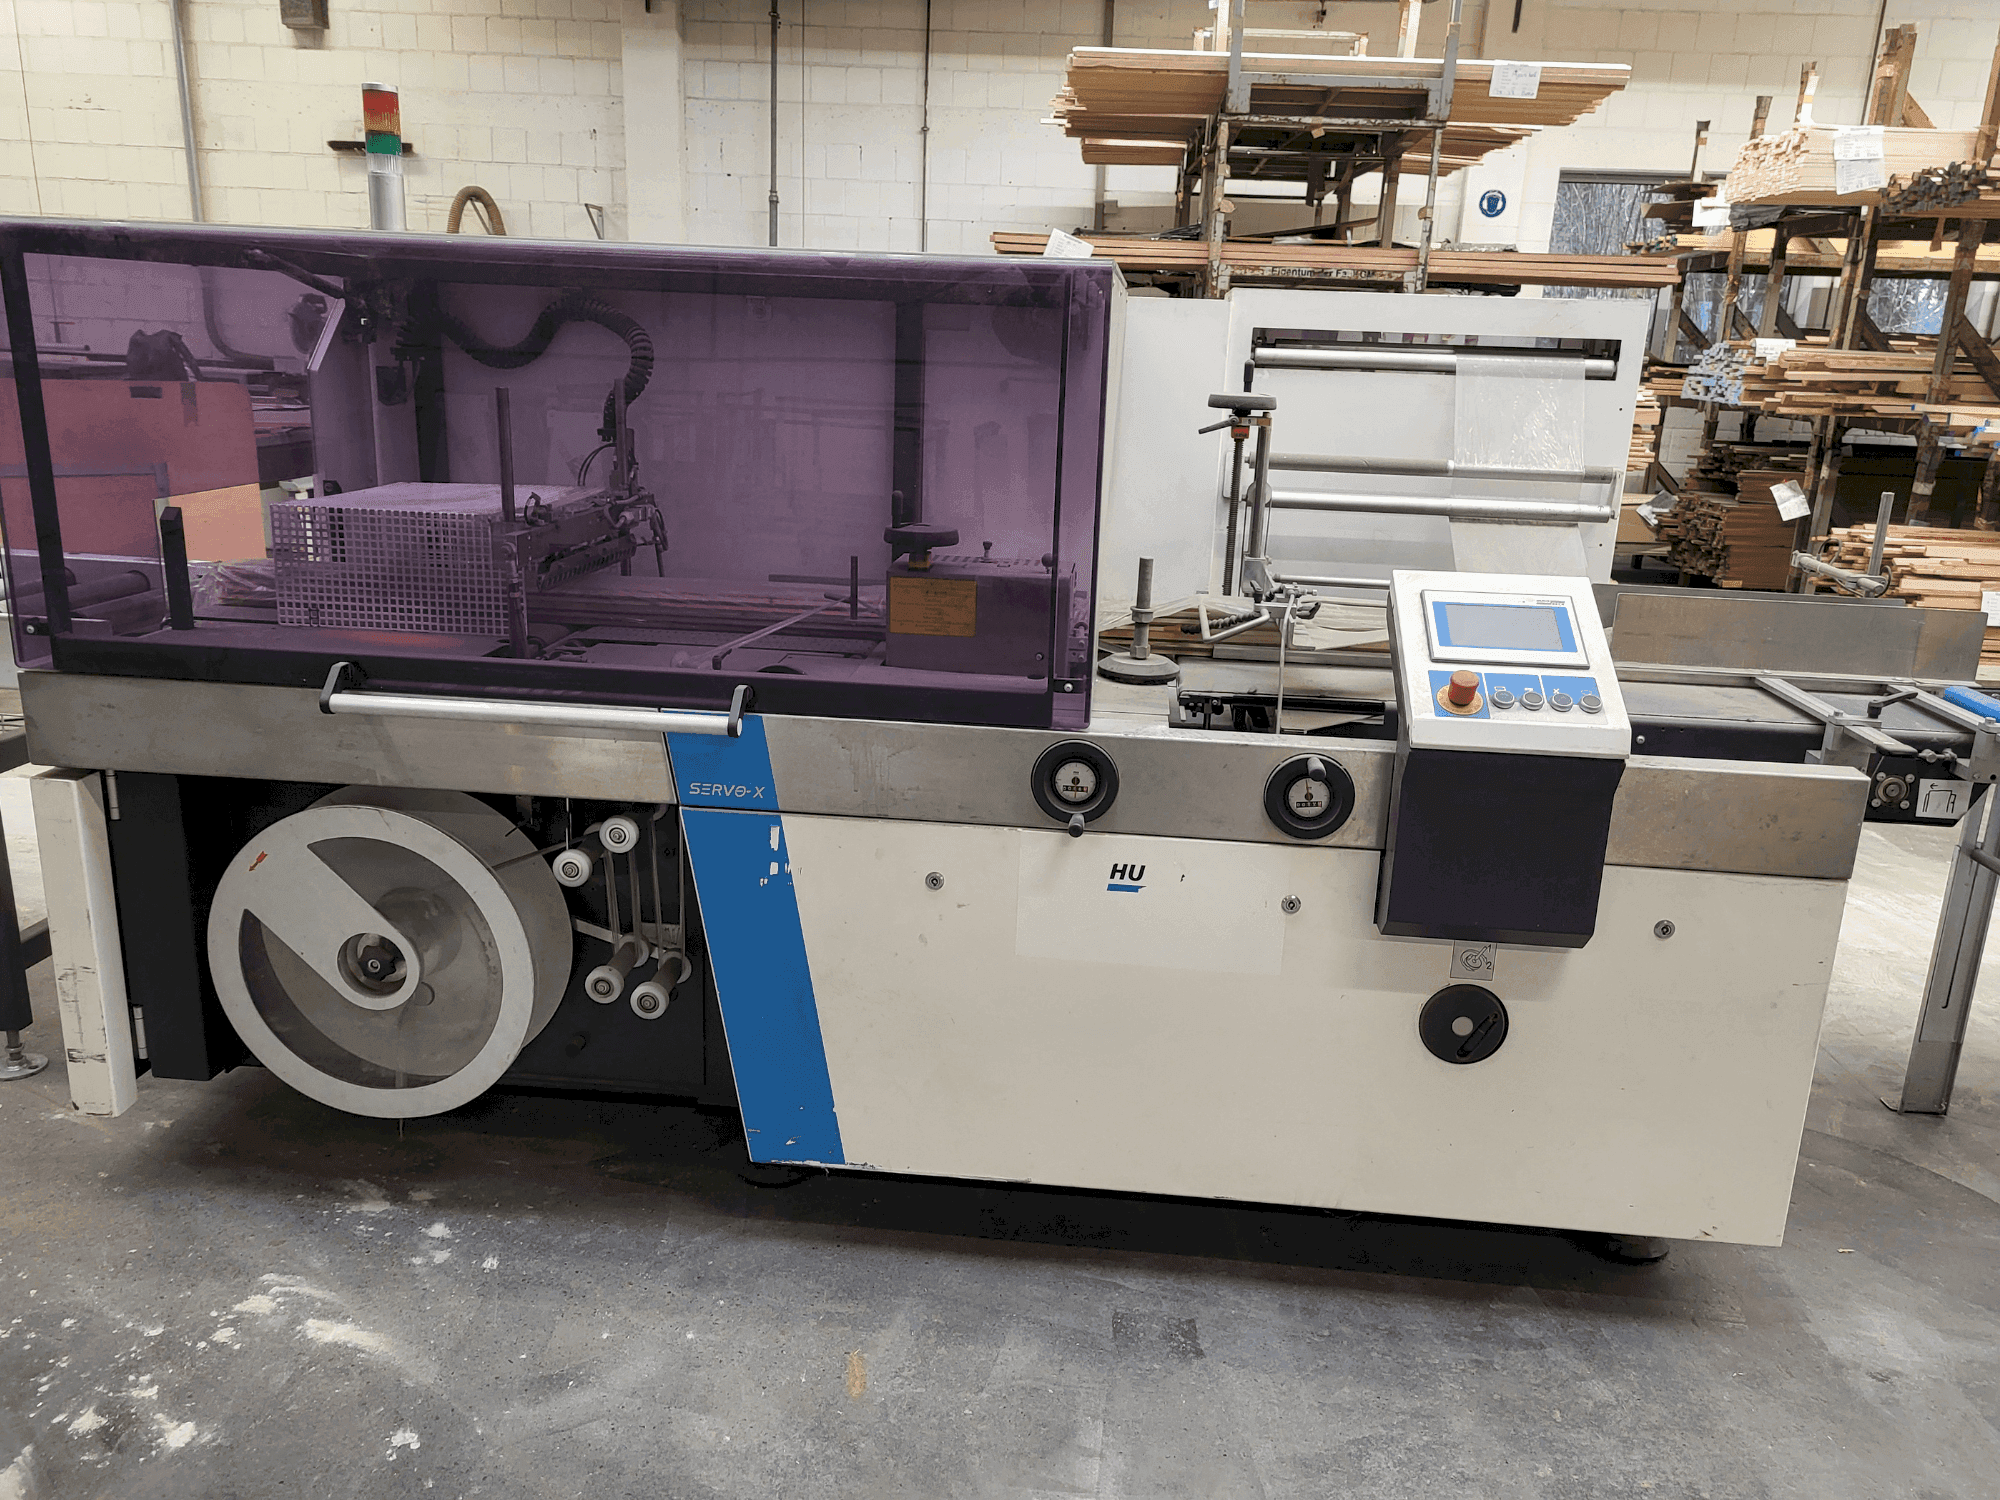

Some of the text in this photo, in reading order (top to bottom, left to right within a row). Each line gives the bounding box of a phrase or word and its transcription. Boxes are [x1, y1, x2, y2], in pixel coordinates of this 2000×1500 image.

[689, 782, 766, 799] SERVO-X
[1109, 863, 1146, 882] HU
[1487, 943, 1492, 953] 1
[1485, 960, 1492, 970] 2
